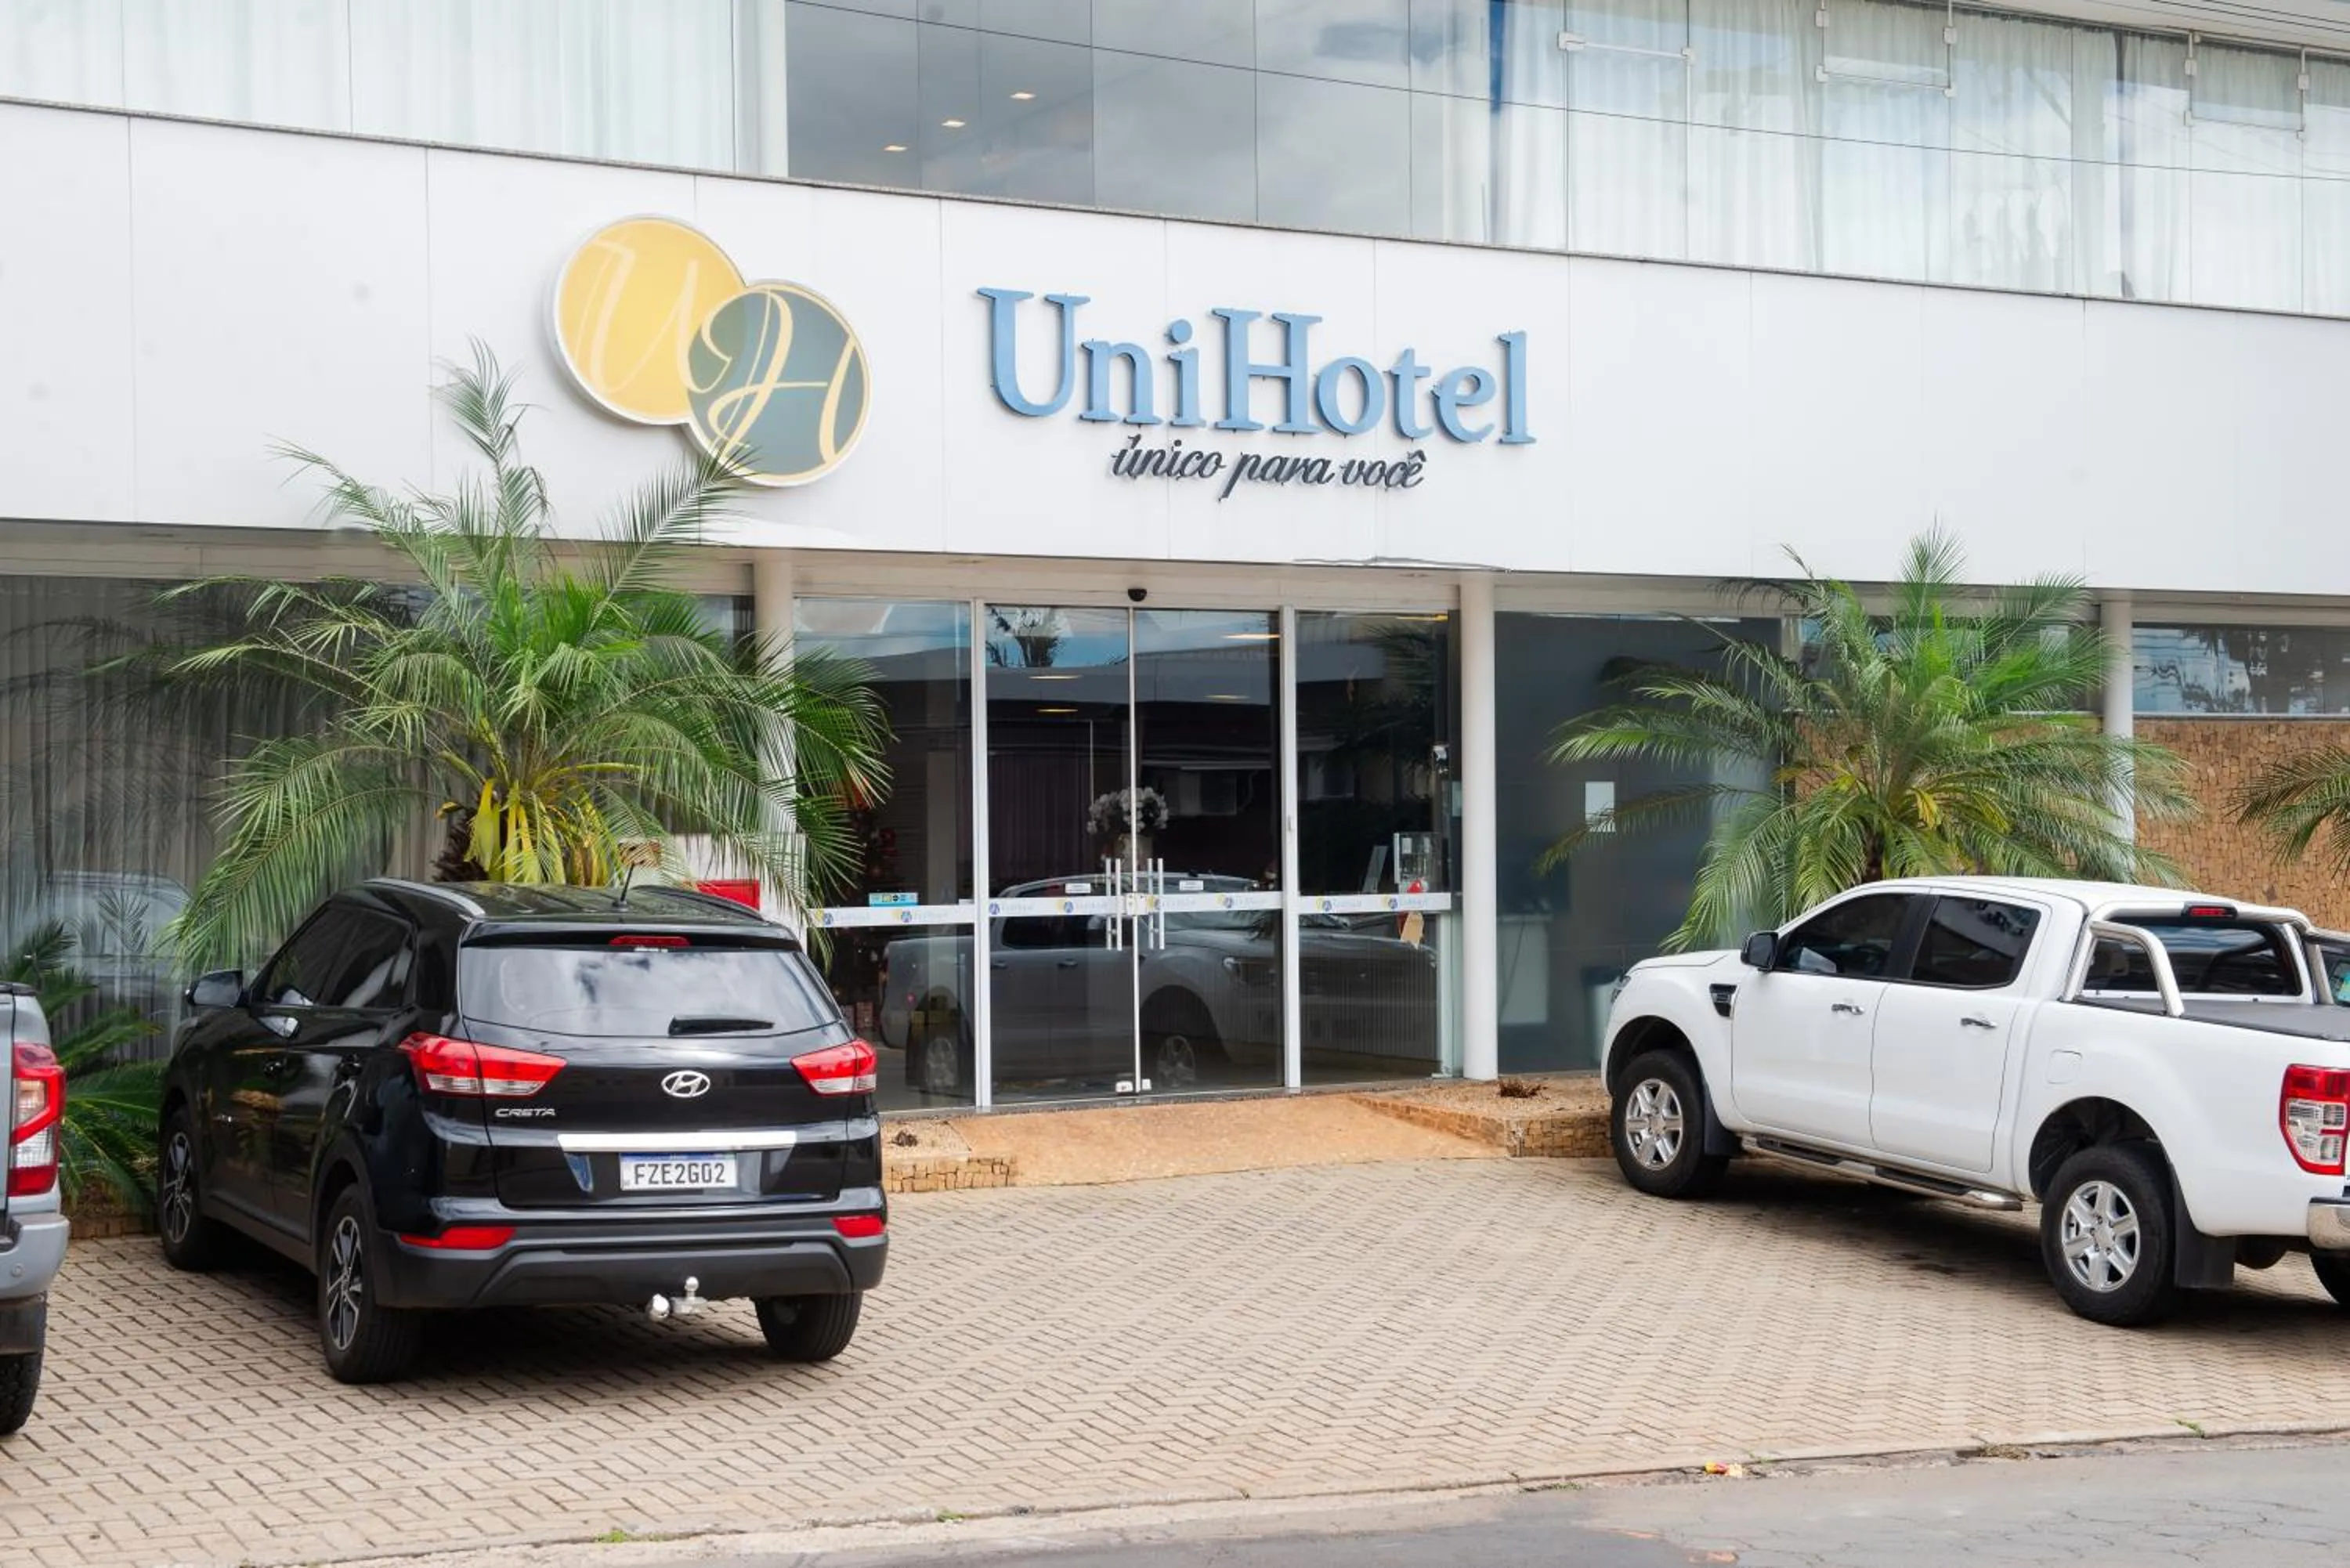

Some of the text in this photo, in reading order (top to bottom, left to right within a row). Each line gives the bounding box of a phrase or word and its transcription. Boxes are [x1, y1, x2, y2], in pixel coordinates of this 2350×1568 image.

[976, 286, 1537, 445] UniHotel
[1111, 433, 1427, 503] único para você
[495, 1108, 555, 1118] CRETA
[634, 1162, 725, 1185] FZE2G02
